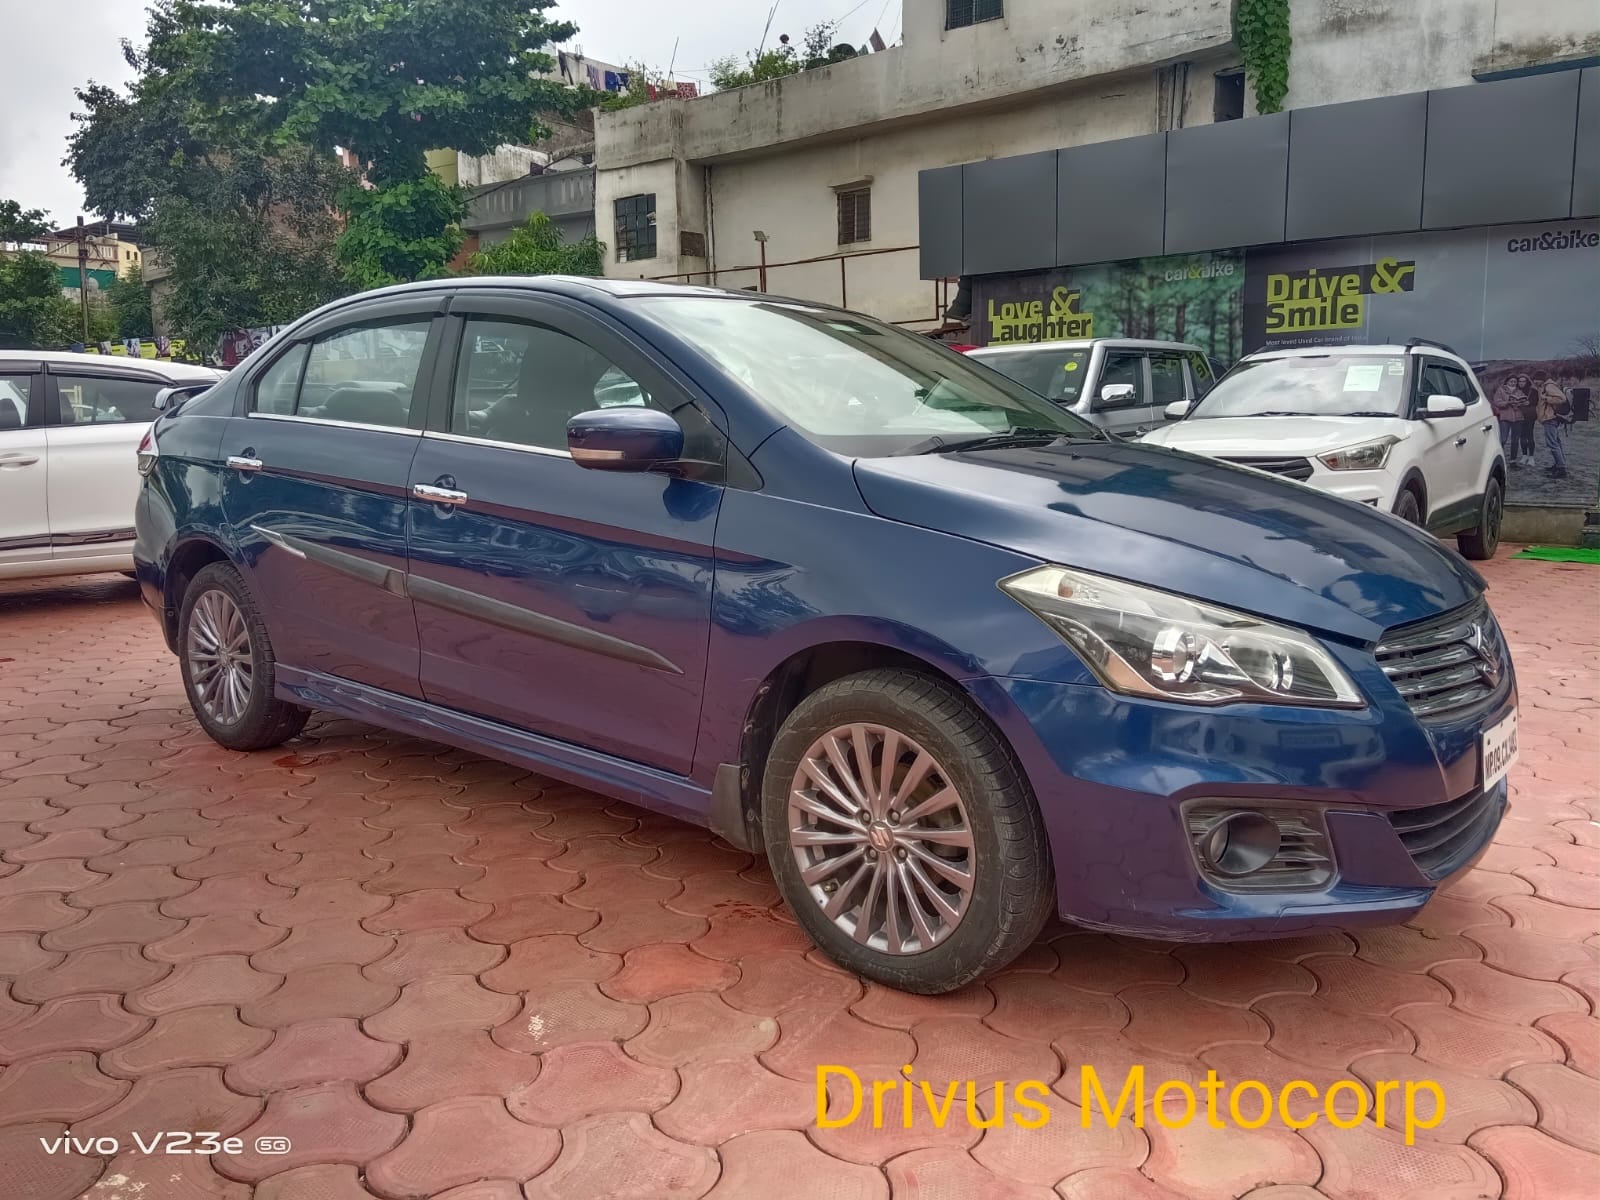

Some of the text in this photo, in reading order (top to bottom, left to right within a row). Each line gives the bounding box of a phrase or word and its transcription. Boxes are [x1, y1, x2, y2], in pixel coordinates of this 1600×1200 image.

[1507, 230, 1600, 253] car&bike
[1165, 261, 1234, 281] car&bike
[1267, 256, 1415, 301] Drive &
[988, 286, 1080, 321] Love &
[1266, 297, 1359, 329] Smile
[988, 316, 1091, 343] Laughter
